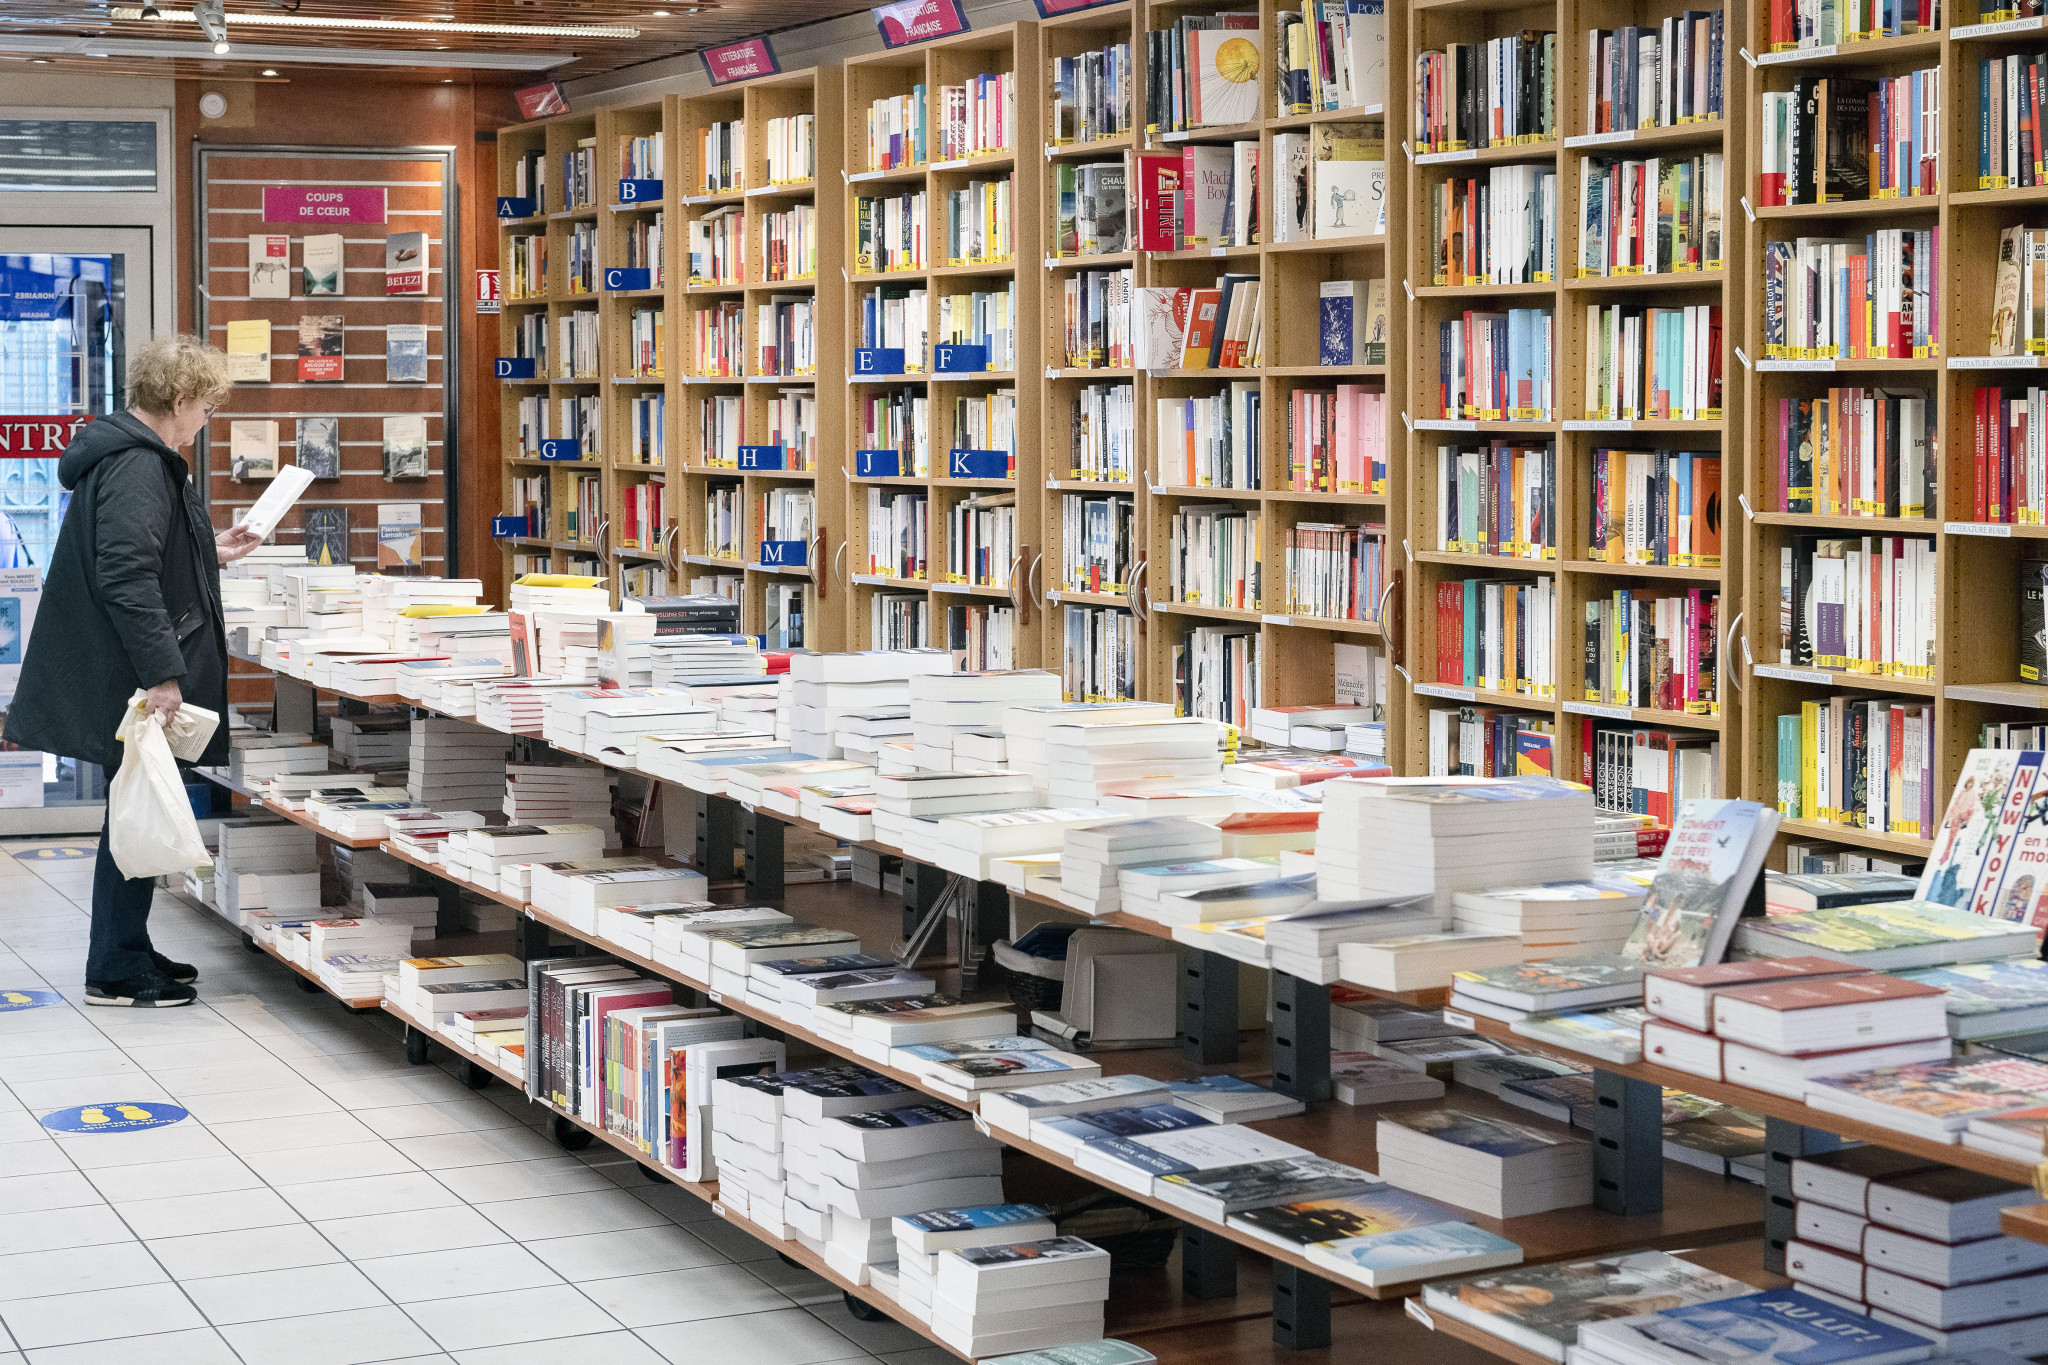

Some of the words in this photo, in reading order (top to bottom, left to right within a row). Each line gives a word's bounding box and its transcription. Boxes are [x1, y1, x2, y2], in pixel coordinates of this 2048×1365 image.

[306, 193, 343, 202] COUPS
[622, 183, 636, 200] B
[299, 207, 314, 216] DE
[317, 206, 350, 216] CŒUR
[499, 200, 514, 216] A
[860, 200, 867, 209] LE
[386, 274, 421, 287] BELEZI
[607, 271, 622, 288] C
[1766, 278, 1775, 321] CHARLOTTE
[858, 351, 874, 371] E
[939, 349, 953, 369] F
[497, 360, 512, 376] D
[542, 442, 557, 459] G
[741, 449, 758, 467] H
[863, 453, 873, 473] J
[952, 453, 972, 473] K
[494, 520, 507, 535] L
[1988, 526, 2008, 535] RUSSE
[764, 544, 784, 563] M
[1622, 596, 1627, 604] LE
[2002, 769, 2033, 826] New
[2024, 836, 2041, 847] en
[1974, 834, 2012, 916] York
[544, 1058, 550, 1069] AU
[559, 1068, 565, 1079] AU
[1761, 1301, 1821, 1318] AU
